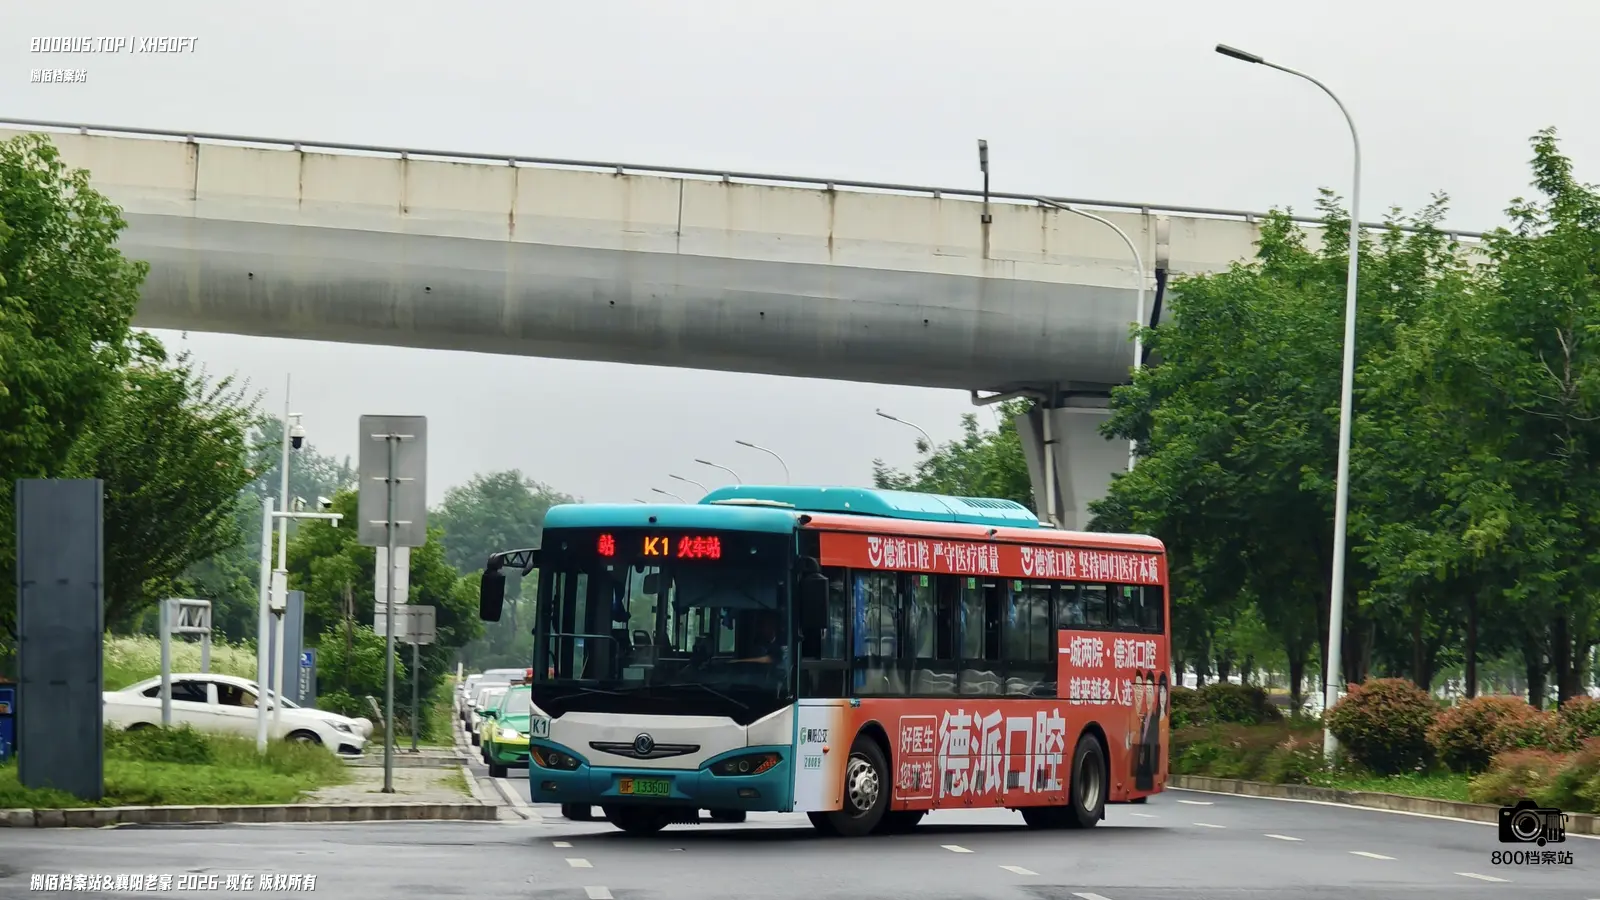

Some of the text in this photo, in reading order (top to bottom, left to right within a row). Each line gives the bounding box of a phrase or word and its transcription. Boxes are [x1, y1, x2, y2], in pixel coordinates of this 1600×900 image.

[598, 534, 720, 558] 站 K1 火车站
[883, 538, 999, 574] 德派口腔 严守医疗质量
[1034, 548, 1159, 582] 德派口腔 坚持回归医疗本质
[1069, 676, 1133, 706] 越来越多人选
[533, 721, 547, 734] K1
[901, 725, 934, 754] 好医生
[938, 708, 1066, 798] 德派口腔
[900, 761, 933, 791] 您来选
